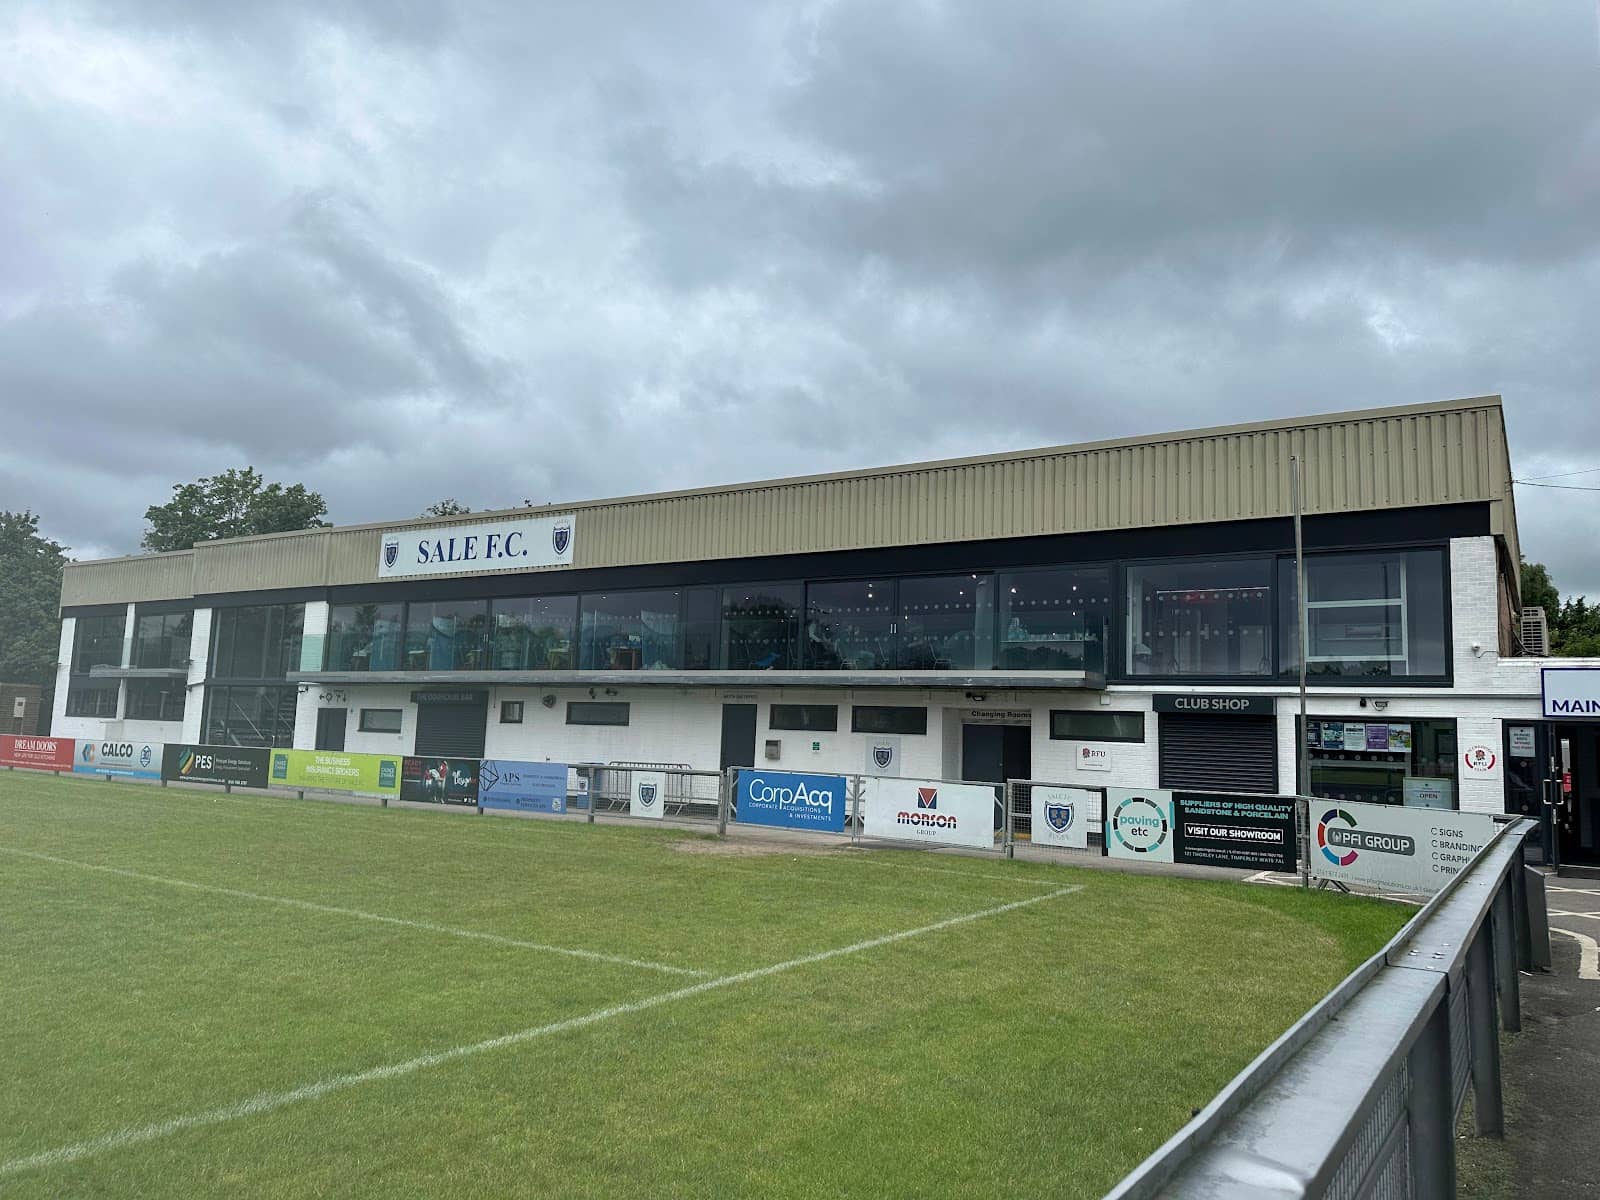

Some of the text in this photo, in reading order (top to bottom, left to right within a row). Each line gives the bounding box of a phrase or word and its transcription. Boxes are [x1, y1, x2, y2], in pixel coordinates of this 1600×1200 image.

[417, 531, 528, 564] SALE F.C.
[1175, 698, 1249, 710] CLUB SHOP
[1552, 699, 1600, 713] MAIN
[14, 739, 57, 751] DREAM DOORS
[102, 743, 133, 758] CALCO
[195, 755, 213, 769] PES
[502, 771, 520, 783] APS
[750, 779, 833, 814] CorpAcq
[783, 805, 821, 813] ACQUISITIONS
[1180, 799, 1221, 808] SUPPLIERS
[1255, 803, 1293, 812] QUALITY
[1184, 807, 1233, 816] SANDSTONE
[1241, 810, 1289, 819] PORCELAIN
[897, 811, 957, 829] MORSON
[1120, 815, 1159, 828] paving
[1131, 827, 1149, 837] etc
[1187, 826, 1281, 841] VISIT OUR SHOWROOM
[1439, 828, 1464, 838] SIGNS
[1342, 832, 1410, 852] PFI GROUP
